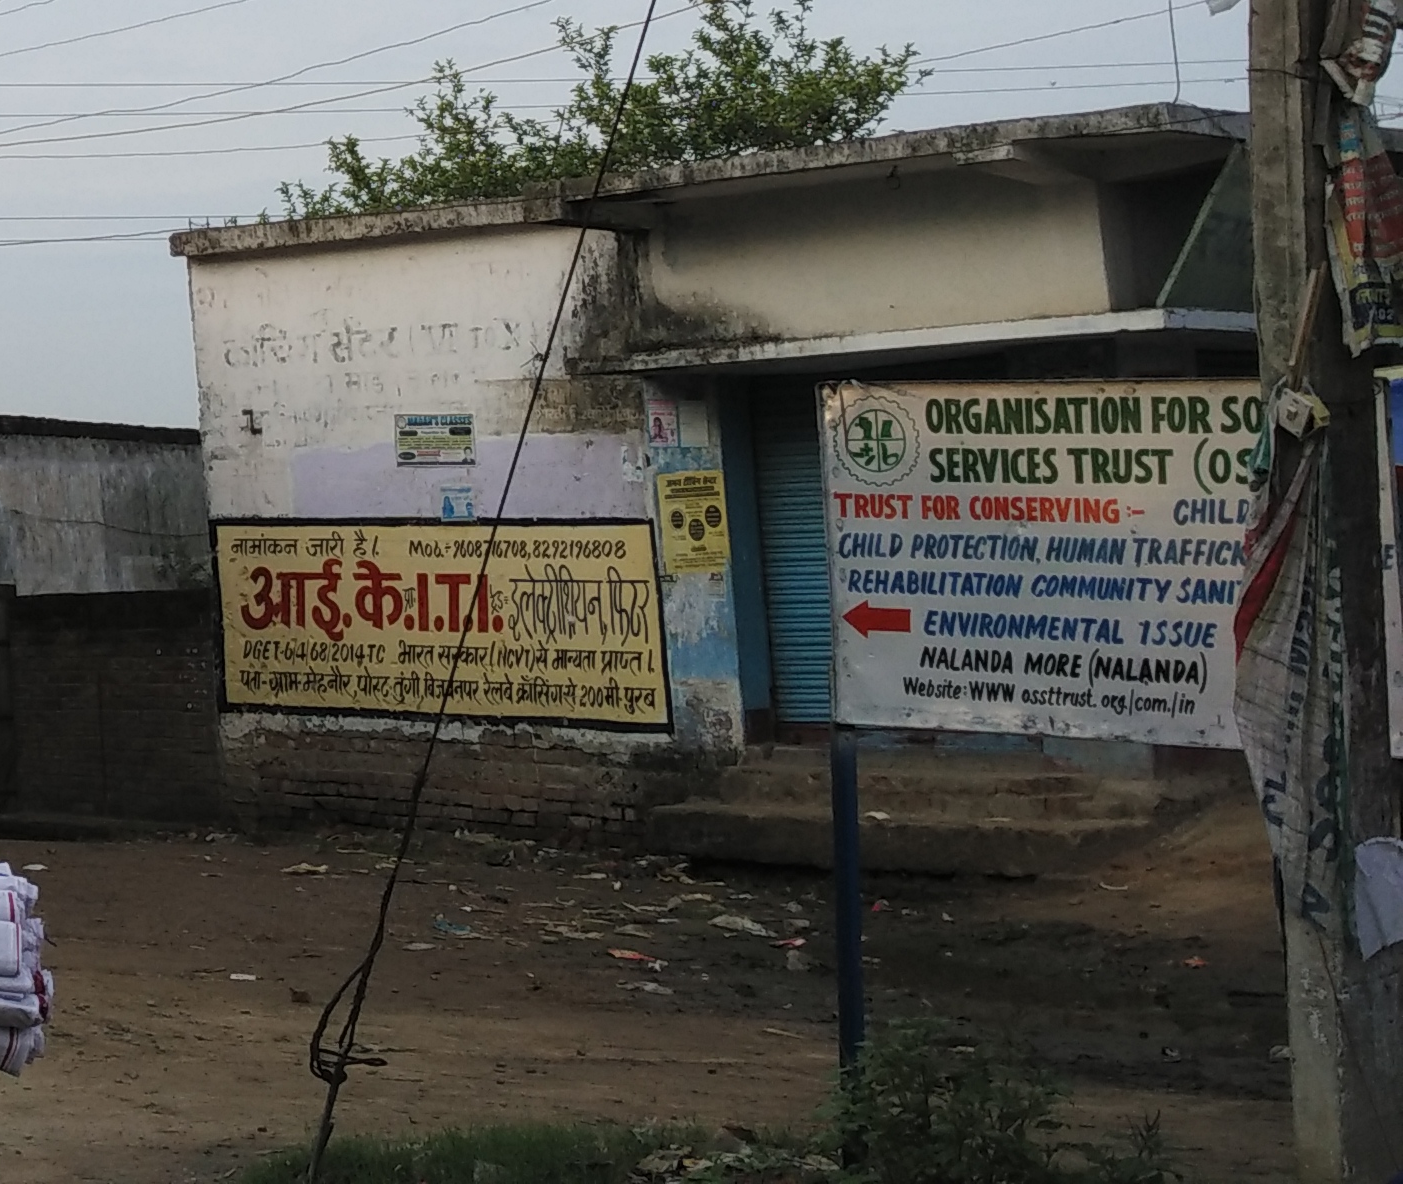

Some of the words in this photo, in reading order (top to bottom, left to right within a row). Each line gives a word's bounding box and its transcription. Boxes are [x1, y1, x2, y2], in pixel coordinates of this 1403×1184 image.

[925, 396, 1144, 435] ORGANISATION
[1151, 397, 1211, 435] FOR
[1219, 397, 1264, 435] SO
[929, 447, 1058, 485] SERVICES
[1068, 447, 1173, 485] TRUST
[1193, 437, 1251, 495] (OS
[834, 492, 913, 521] TRUST
[922, 494, 960, 521] FOR
[968, 496, 1121, 524] CONSERVING
[1173, 498, 1250, 526] CHILD
[231, 533, 299, 557] नामांकन
[305, 531, 345, 558] जारी
[838, 531, 902, 560] CHILD
[911, 534, 1041, 565] PROTECTION,
[1046, 538, 1125, 564] HUMAN
[1133, 538, 1246, 568] TRAFFICK
[847, 567, 1020, 598] REHABILITATION
[1031, 574, 1172, 603] COMMUNITY
[1176, 577, 1241, 606] SANI
[924, 609, 1124, 645] ENVIRONMENTAL
[1138, 618, 1217, 649] ISSUE
[398, 639, 435, 667] भारत
[920, 646, 1014, 675] NALANDA
[1024, 652, 1083, 678] MORE
[1088, 647, 1207, 694] (NALANDA)
